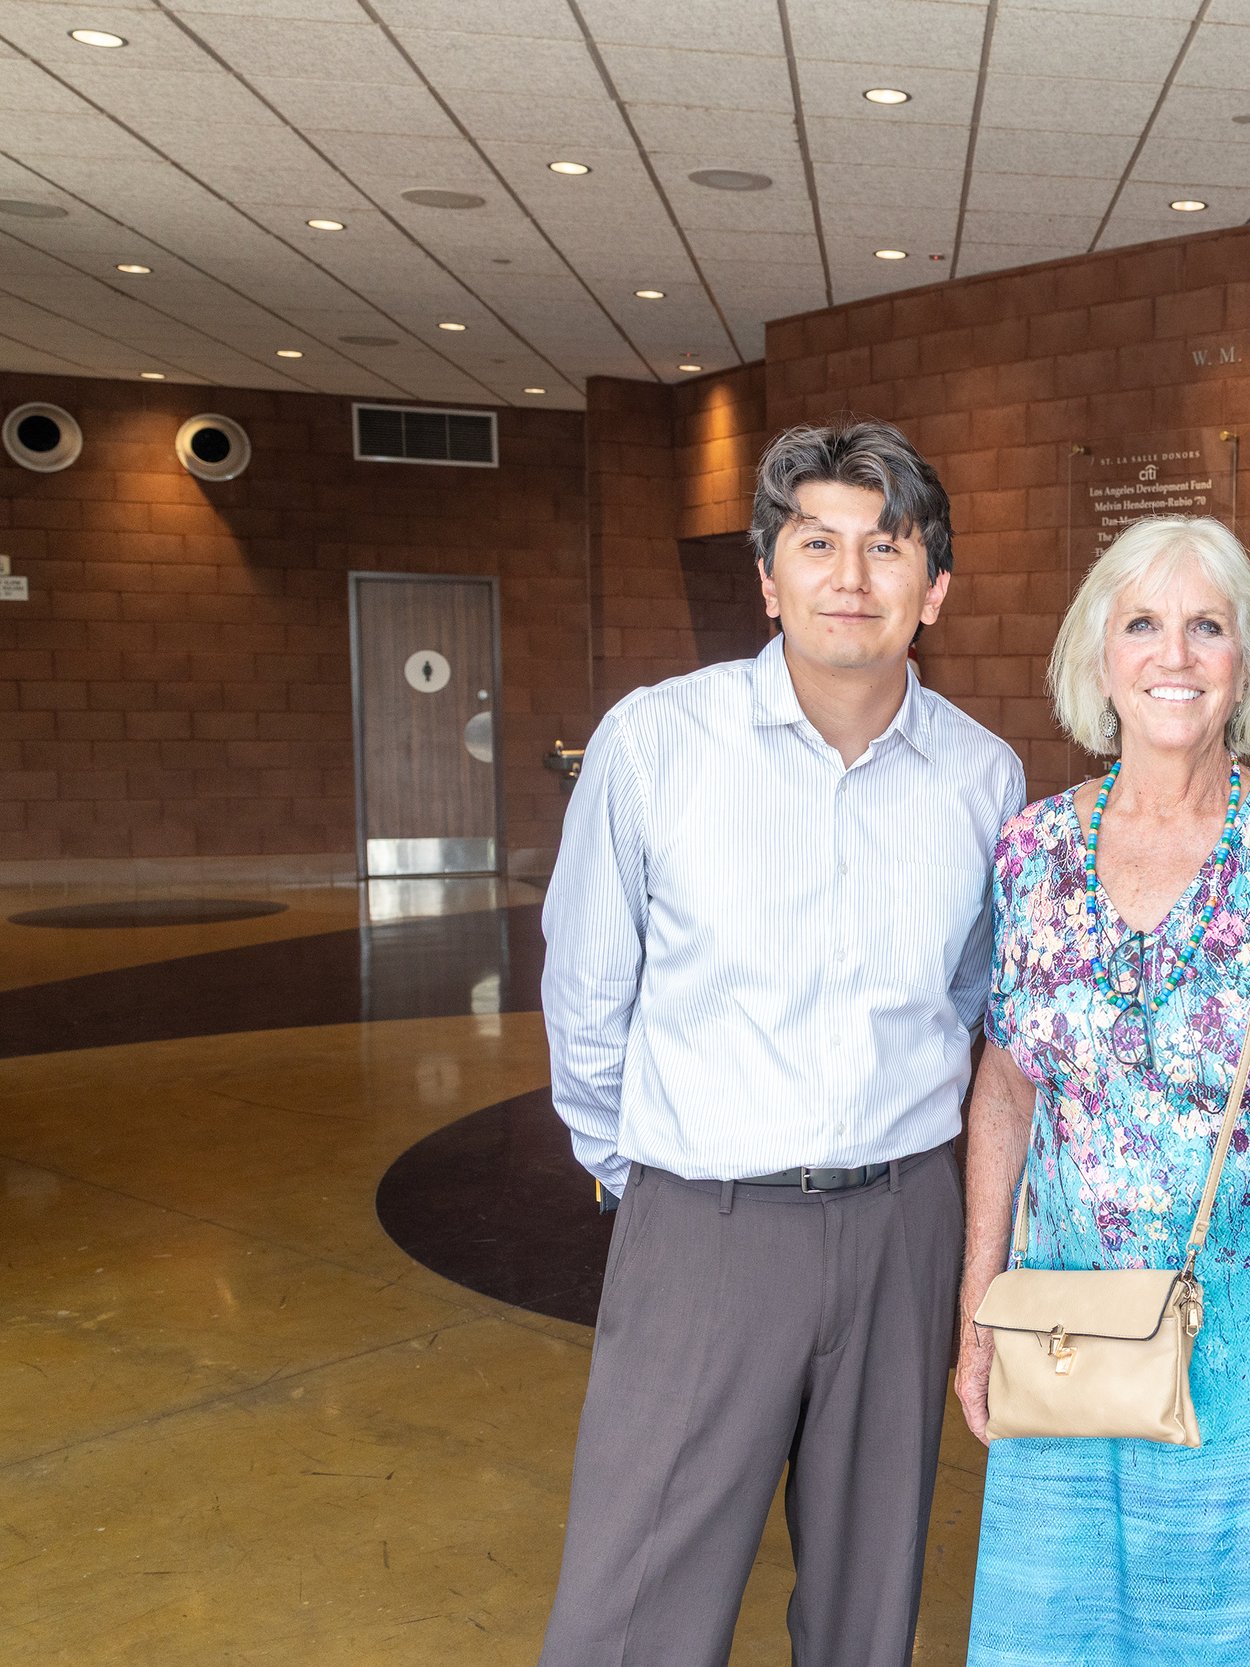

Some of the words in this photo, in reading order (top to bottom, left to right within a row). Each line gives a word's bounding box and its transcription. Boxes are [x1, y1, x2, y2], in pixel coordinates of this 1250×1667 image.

[1191, 350, 1212, 367] W.
[1219, 347, 1242, 364] M.
[1131, 454, 1157, 462] SALLE
[1162, 450, 1201, 460] DONORS
[1138, 465, 1157, 481] citi
[1089, 487, 1103, 497] Los
[1104, 485, 1135, 498] Angeles
[1136, 481, 1189, 494] Development
[1190, 479, 1213, 490] Fund
[1095, 500, 1122, 512] Melvin
[1123, 497, 1193, 510] Henderson-Rubio
